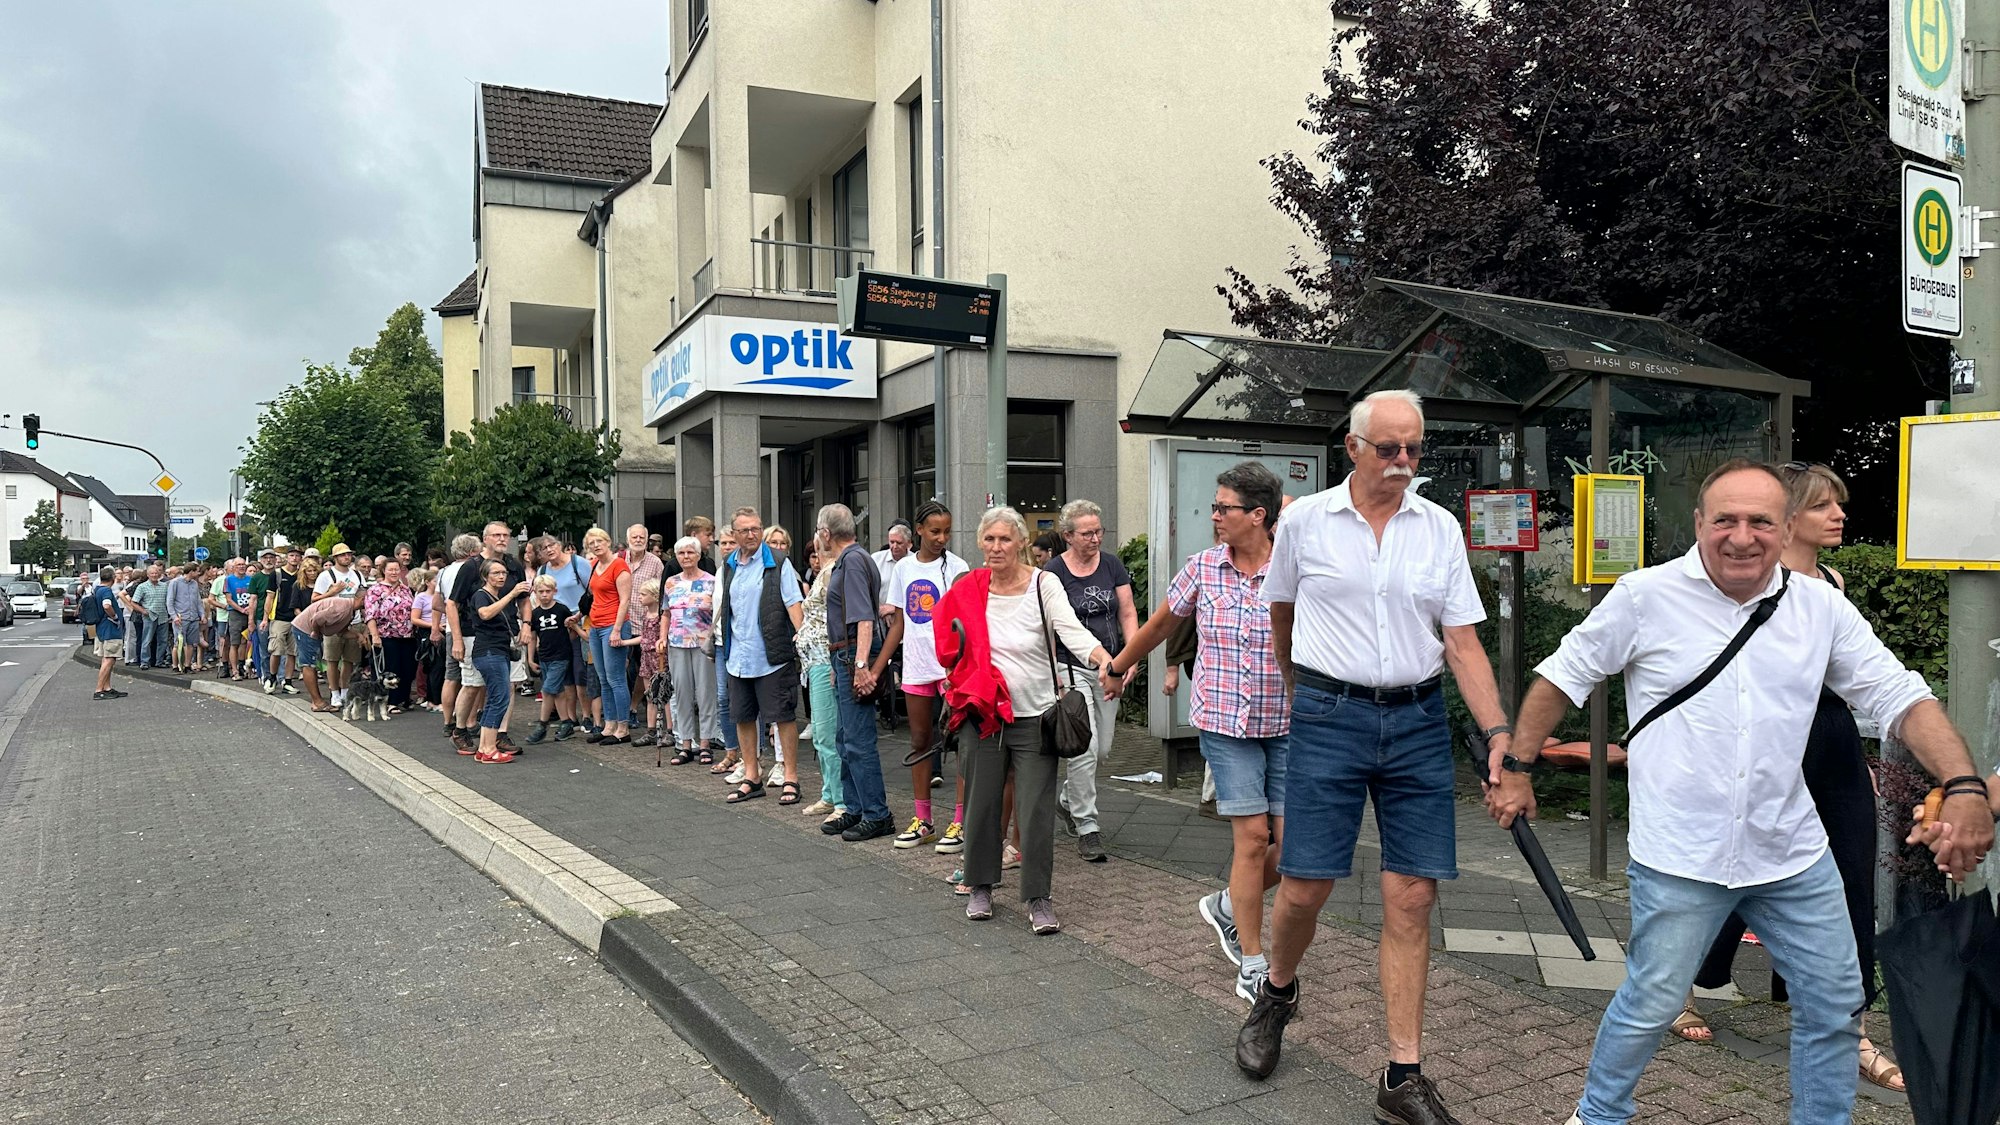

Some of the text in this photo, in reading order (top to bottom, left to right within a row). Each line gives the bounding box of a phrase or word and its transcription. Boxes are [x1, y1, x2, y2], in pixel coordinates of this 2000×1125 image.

[1920, 0, 1939, 64] H
[1897, 85, 1962, 122] Seelscheid Post A
[1898, 103, 1914, 120] Linie
[1919, 111, 1928, 125] SB
[1930, 116, 1938, 129] 56
[1926, 206, 1941, 250] H
[868, 284, 938, 301] SB56 Siegburg Bf
[1910, 274, 1956, 298] BÜRGERBUS
[867, 293, 937, 311] SB56 Siegburg Bf
[968, 306, 978, 314] 34
[730, 329, 854, 375] optik
[651, 341, 691, 404] optik euler
[1629, 361, 1640, 370] IST
